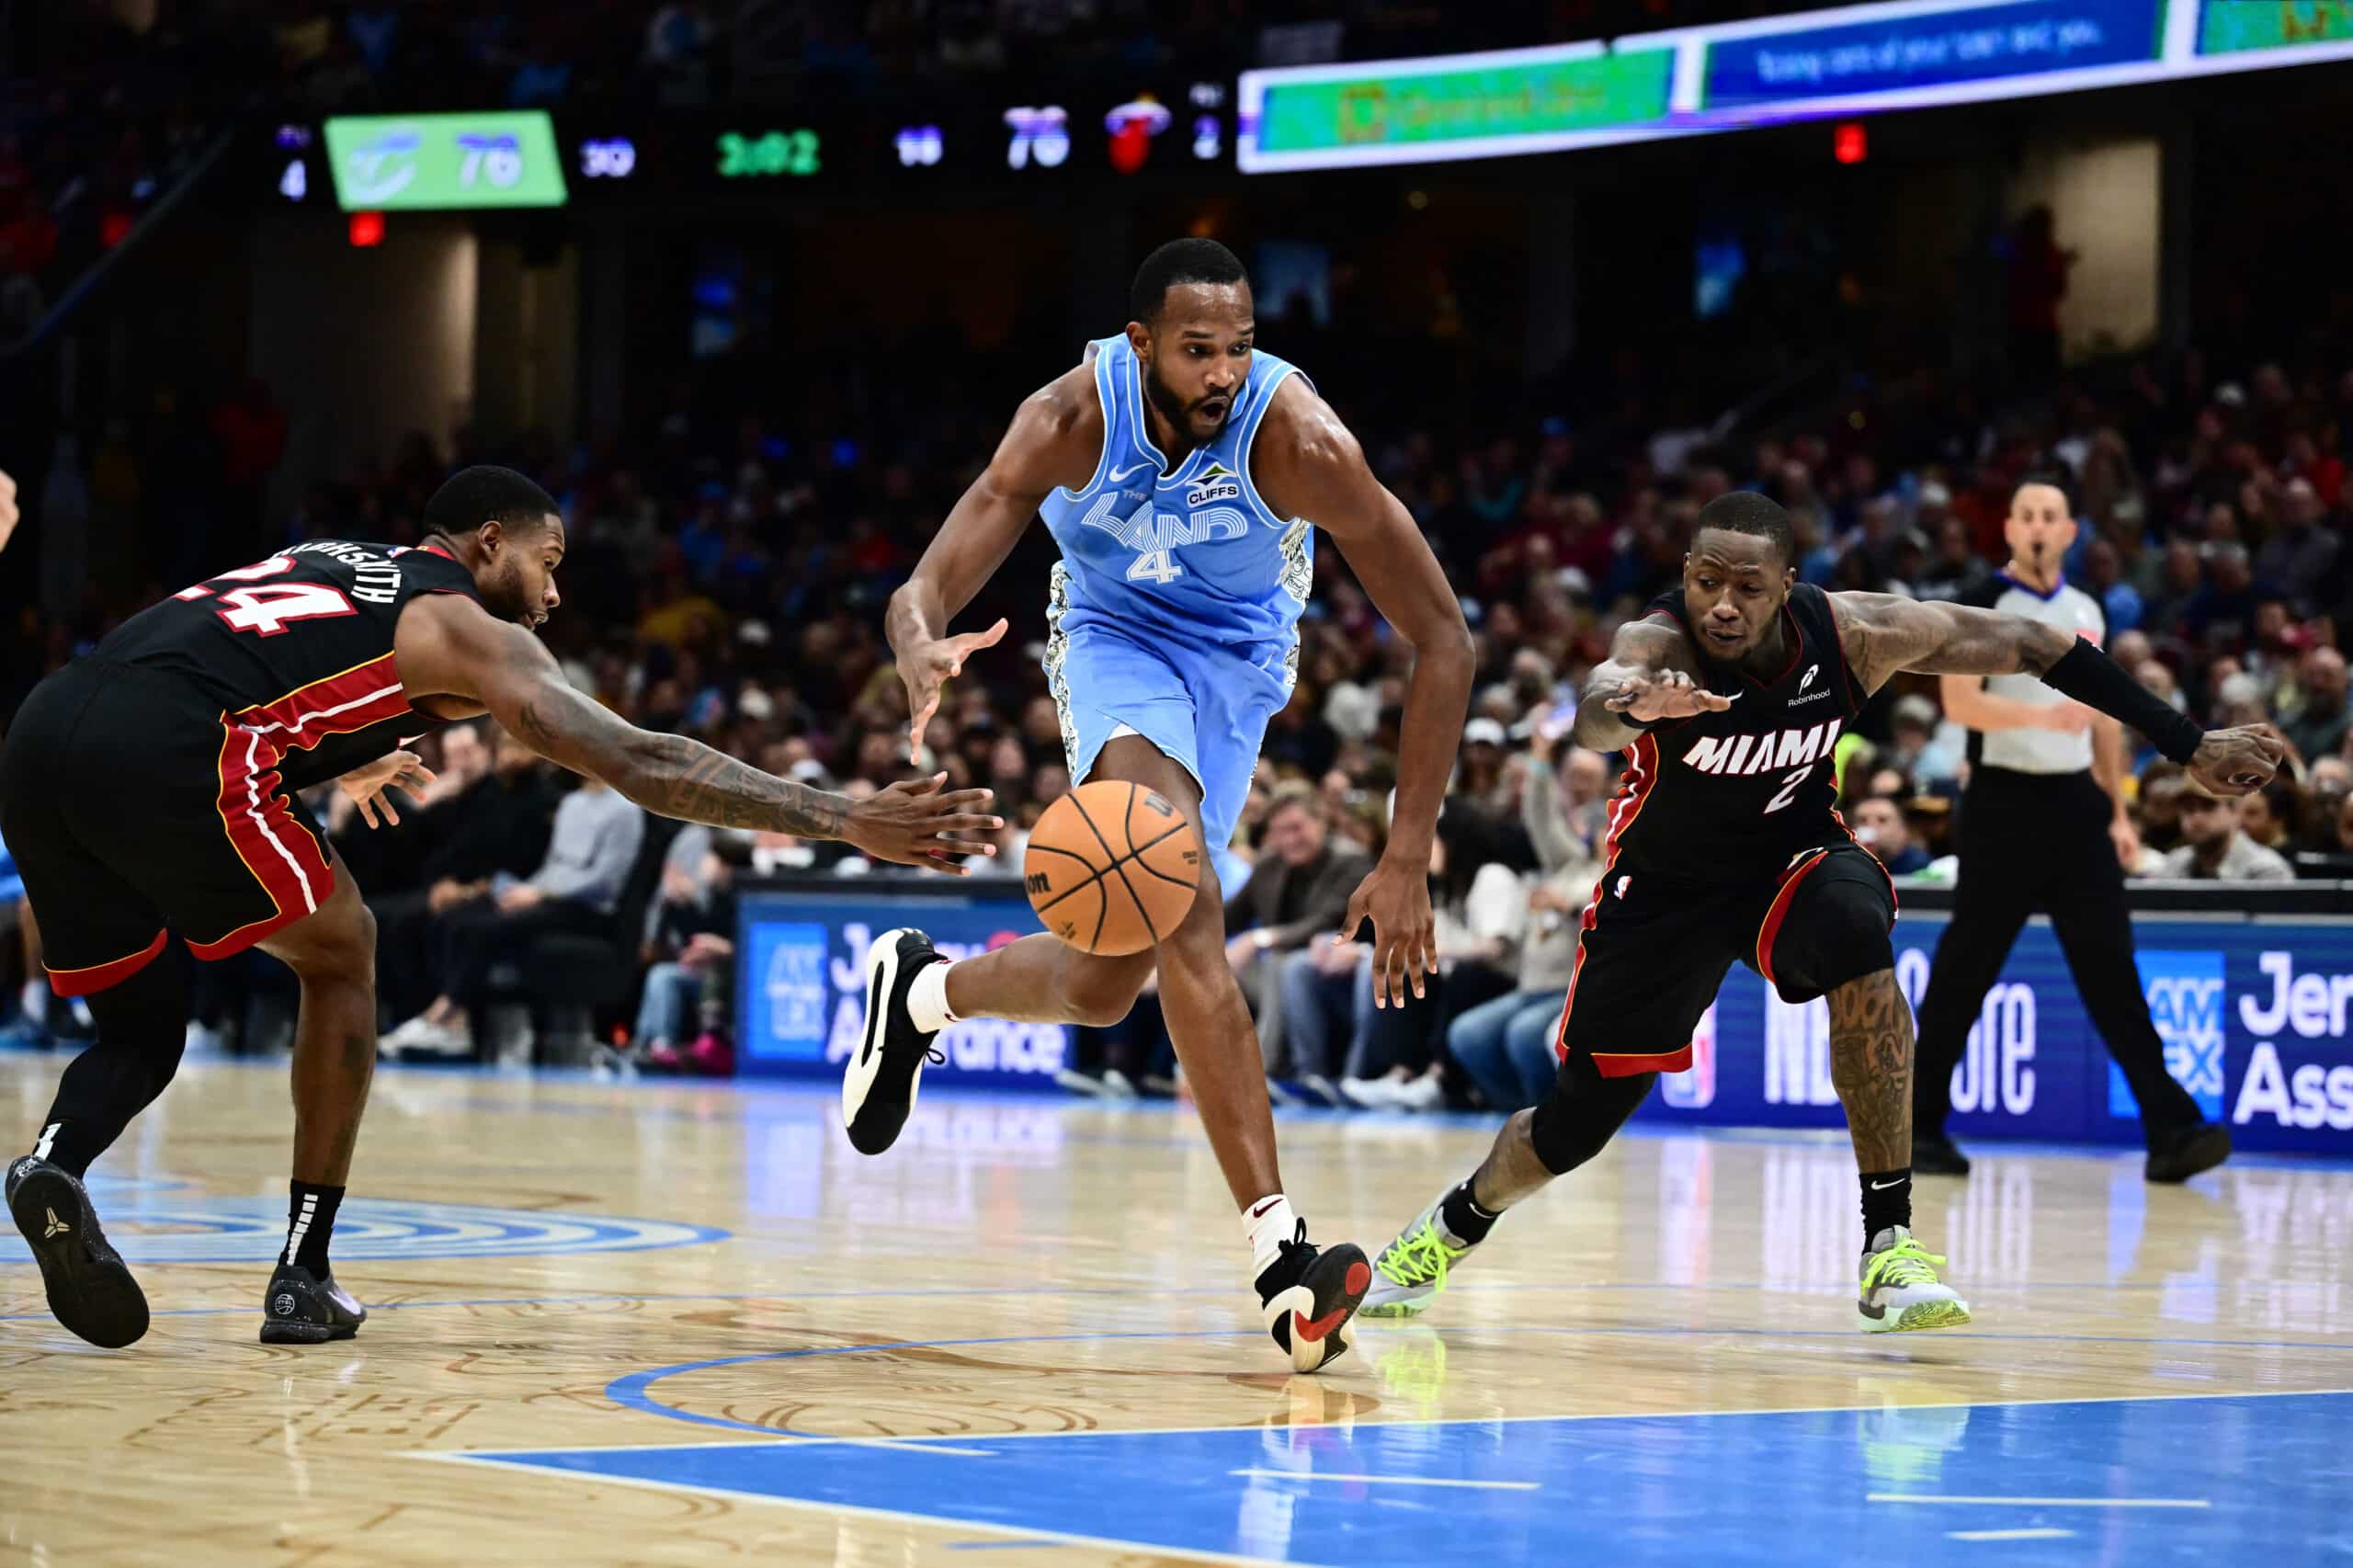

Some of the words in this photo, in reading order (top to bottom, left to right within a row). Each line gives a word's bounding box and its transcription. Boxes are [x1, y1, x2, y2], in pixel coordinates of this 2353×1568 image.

[456, 131, 522, 189] 76
[1003, 105, 1071, 170] 76
[1121, 488, 1148, 501] THE
[1188, 485, 1238, 505] CLIFFS
[1081, 491, 1248, 551] LAND
[1126, 549, 1183, 585] 4
[1788, 687, 1831, 708] Robinhood
[1681, 718, 1843, 775] MIAMI
[1763, 764, 1814, 814] 2
